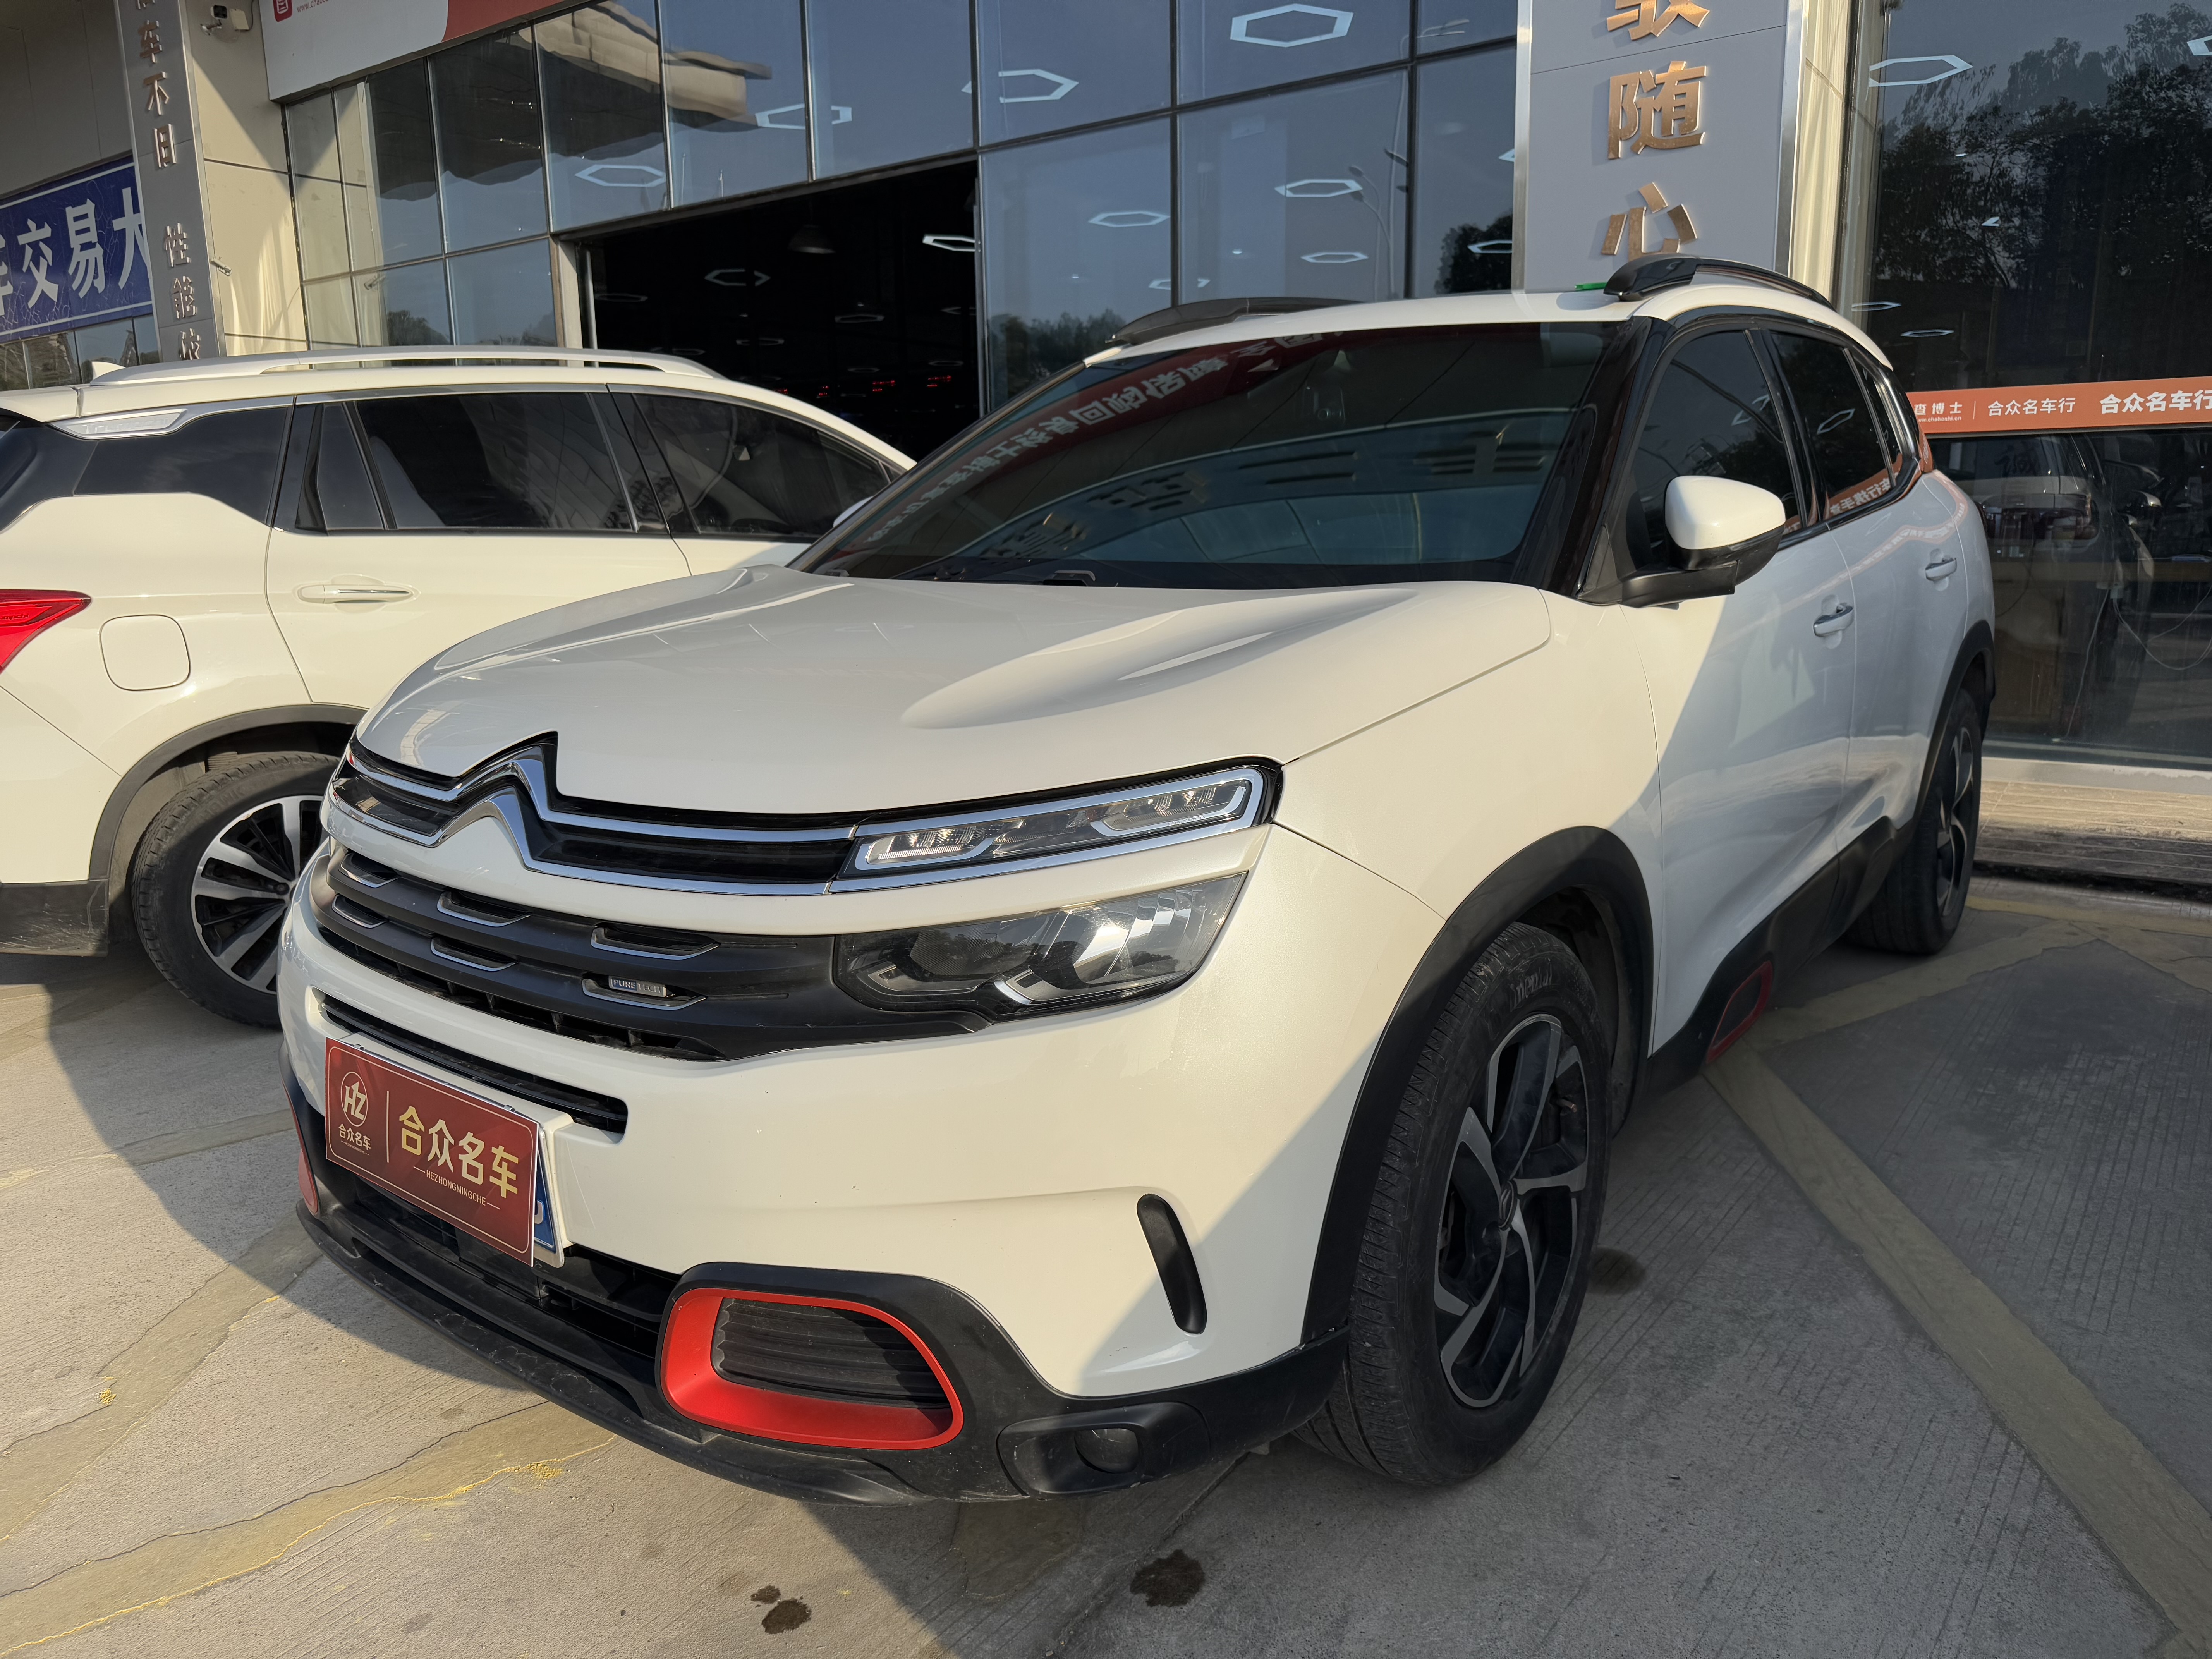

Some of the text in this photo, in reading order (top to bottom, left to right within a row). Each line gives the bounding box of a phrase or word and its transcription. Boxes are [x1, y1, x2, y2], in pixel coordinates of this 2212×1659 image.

[136, 0, 177, 168] 车不旧
[1914, 401, 1963, 416] 查博士
[1988, 397, 2076, 417] 合众名车行
[2099, 389, 2212, 414] 合众名车行
[344, 1081, 366, 1120] HZ
[338, 1123, 371, 1150] 合众名车
[399, 1105, 519, 1199] 合众名车
[426, 1169, 487, 1206] HEZHONGMINGCHE
